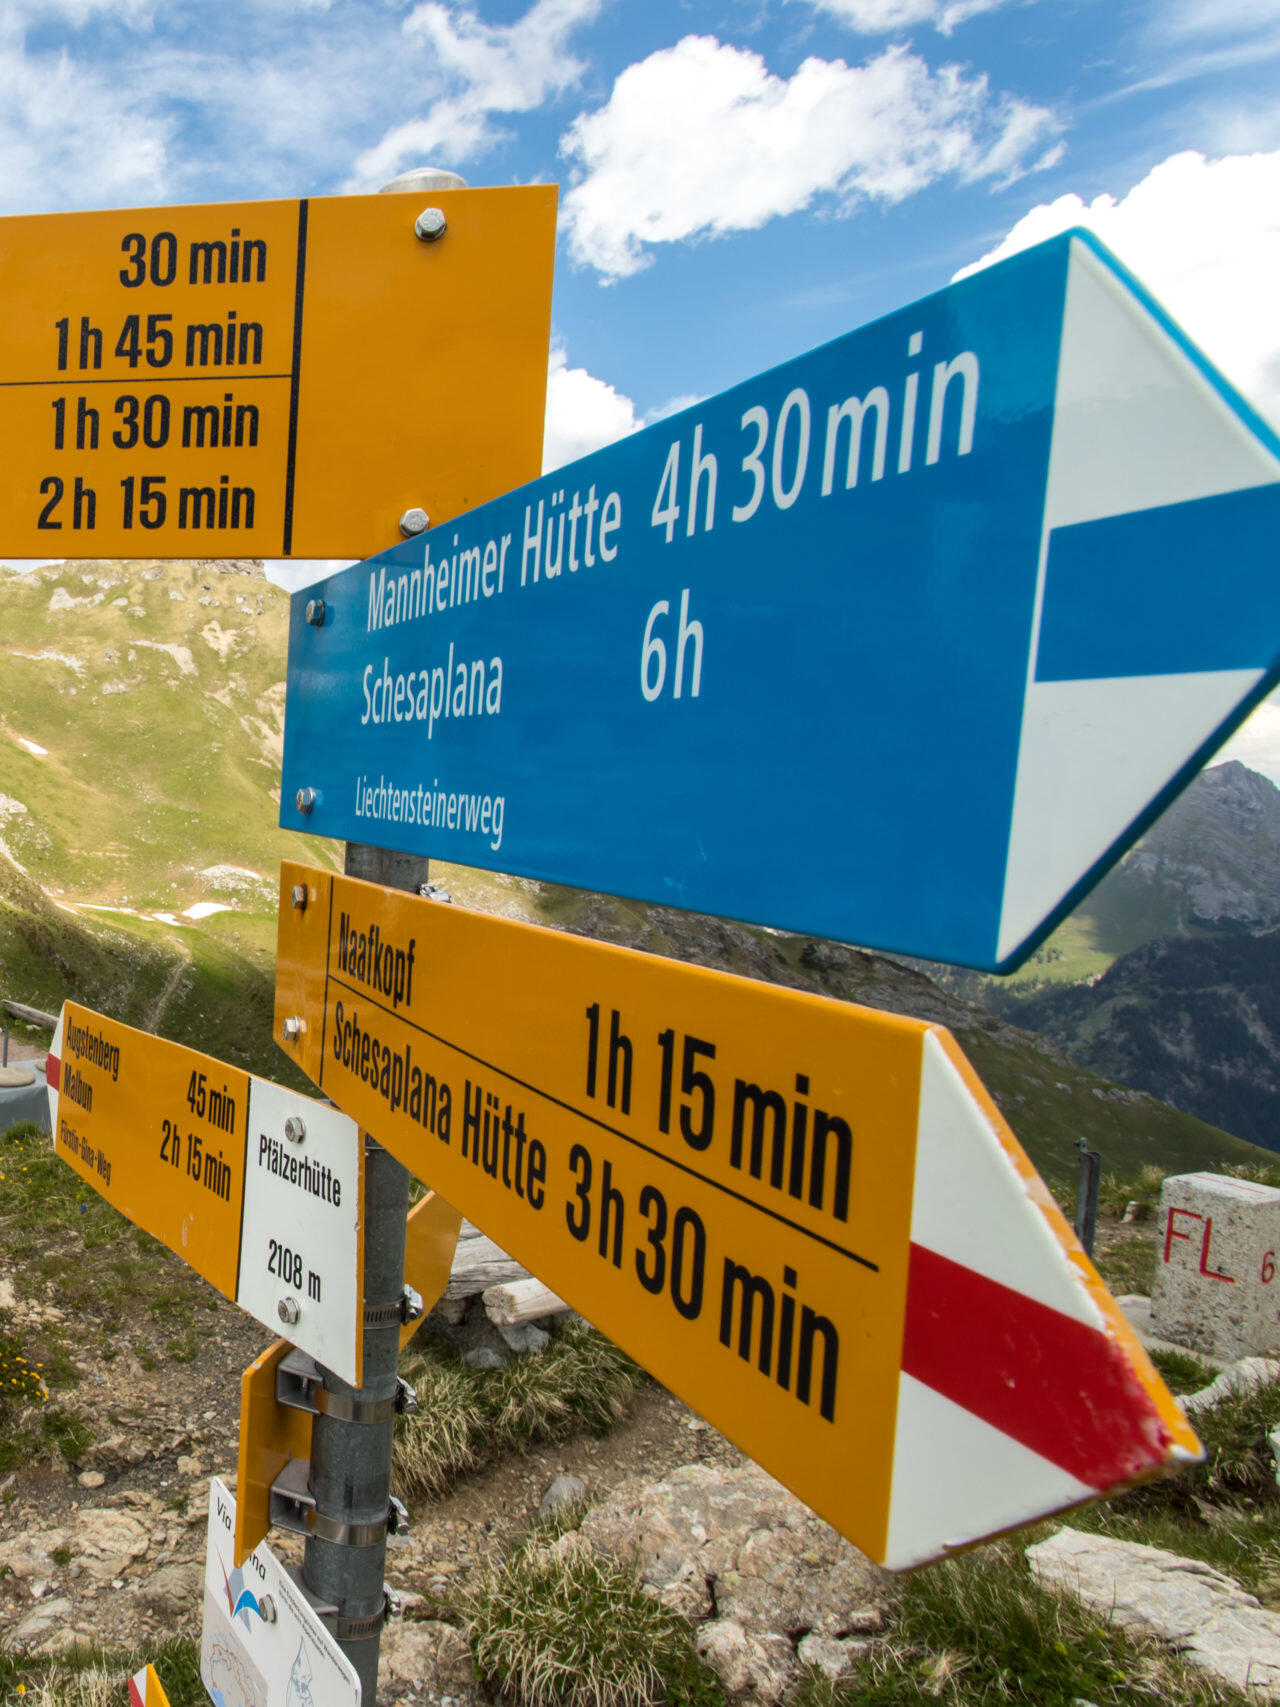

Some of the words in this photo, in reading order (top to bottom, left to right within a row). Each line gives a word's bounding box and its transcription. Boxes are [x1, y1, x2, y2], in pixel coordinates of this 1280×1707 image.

[119, 231, 179, 288] 30
[189, 228, 267, 285] min
[114, 313, 174, 369] 45
[185, 310, 263, 367] min
[112, 394, 171, 450] 30
[181, 392, 260, 448] min
[119, 476, 168, 530] 15
[178, 475, 257, 530] min
[366, 532, 513, 634] Mannheimer
[520, 484, 623, 588] Hütte
[731, 387, 812, 524] 30
[820, 330, 981, 498] min
[360, 642, 504, 740] Schesaplana
[354, 775, 506, 852] Liechtensteinerweg
[66, 1015, 120, 1082] Augstenberg
[186, 1069, 208, 1119] 45
[208, 1085, 236, 1135] min
[338, 911, 417, 1008] Naafkopf
[656, 1027, 718, 1153] 15
[728, 1072, 854, 1224] min
[63, 1062, 93, 1114] Malbun
[186, 1132, 203, 1183] 15
[203, 1149, 232, 1203] min
[258, 1132, 342, 1208] Pfälzerhütte
[332, 1001, 453, 1146] Schesaplana
[460, 1079, 548, 1212] Hütte
[634, 1183, 708, 1322] 30
[718, 1255, 841, 1426] min
[1163, 1206, 1235, 1284] FL
[266, 1238, 304, 1291] 2108
[308, 1267, 322, 1304] m
[216, 1495, 233, 1533] Via
